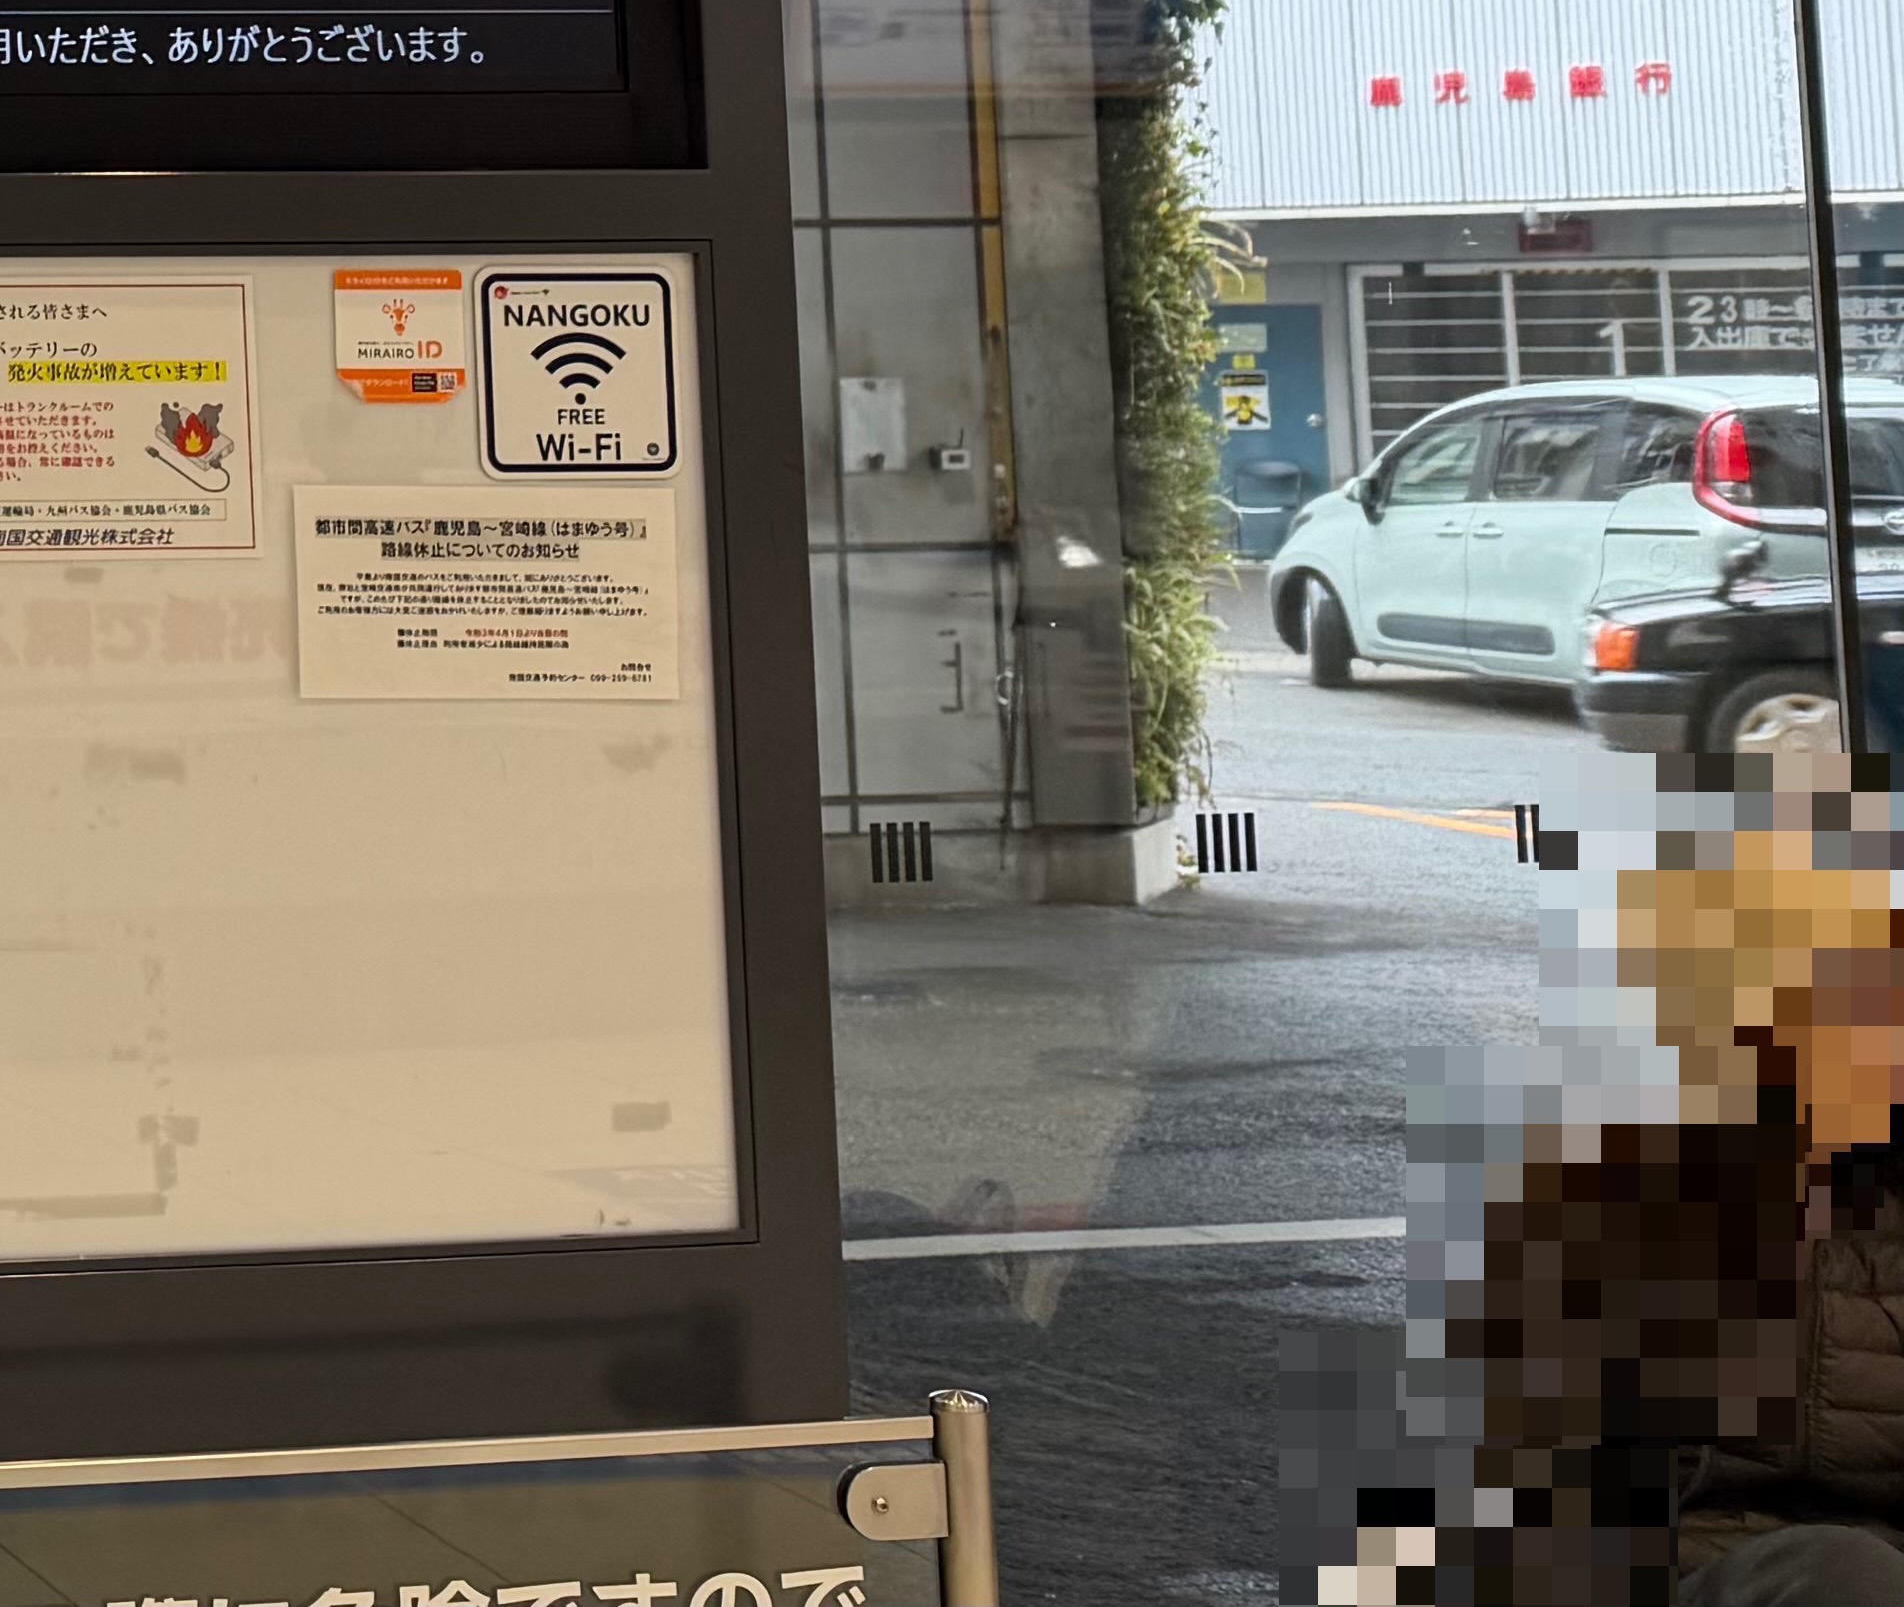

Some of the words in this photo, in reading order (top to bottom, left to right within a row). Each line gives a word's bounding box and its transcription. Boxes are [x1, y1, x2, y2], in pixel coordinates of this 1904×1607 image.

[502, 303, 651, 328] NANGOKU
[356, 347, 416, 360] MIRAIRO
[416, 339, 444, 360] ID
[7, 361, 223, 384] 発火事故が増えています！
[556, 408, 607, 426] FREE
[535, 432, 623, 462] Wi-Fi
[381, 541, 580, 560] 路線休止についてのお知らせ
